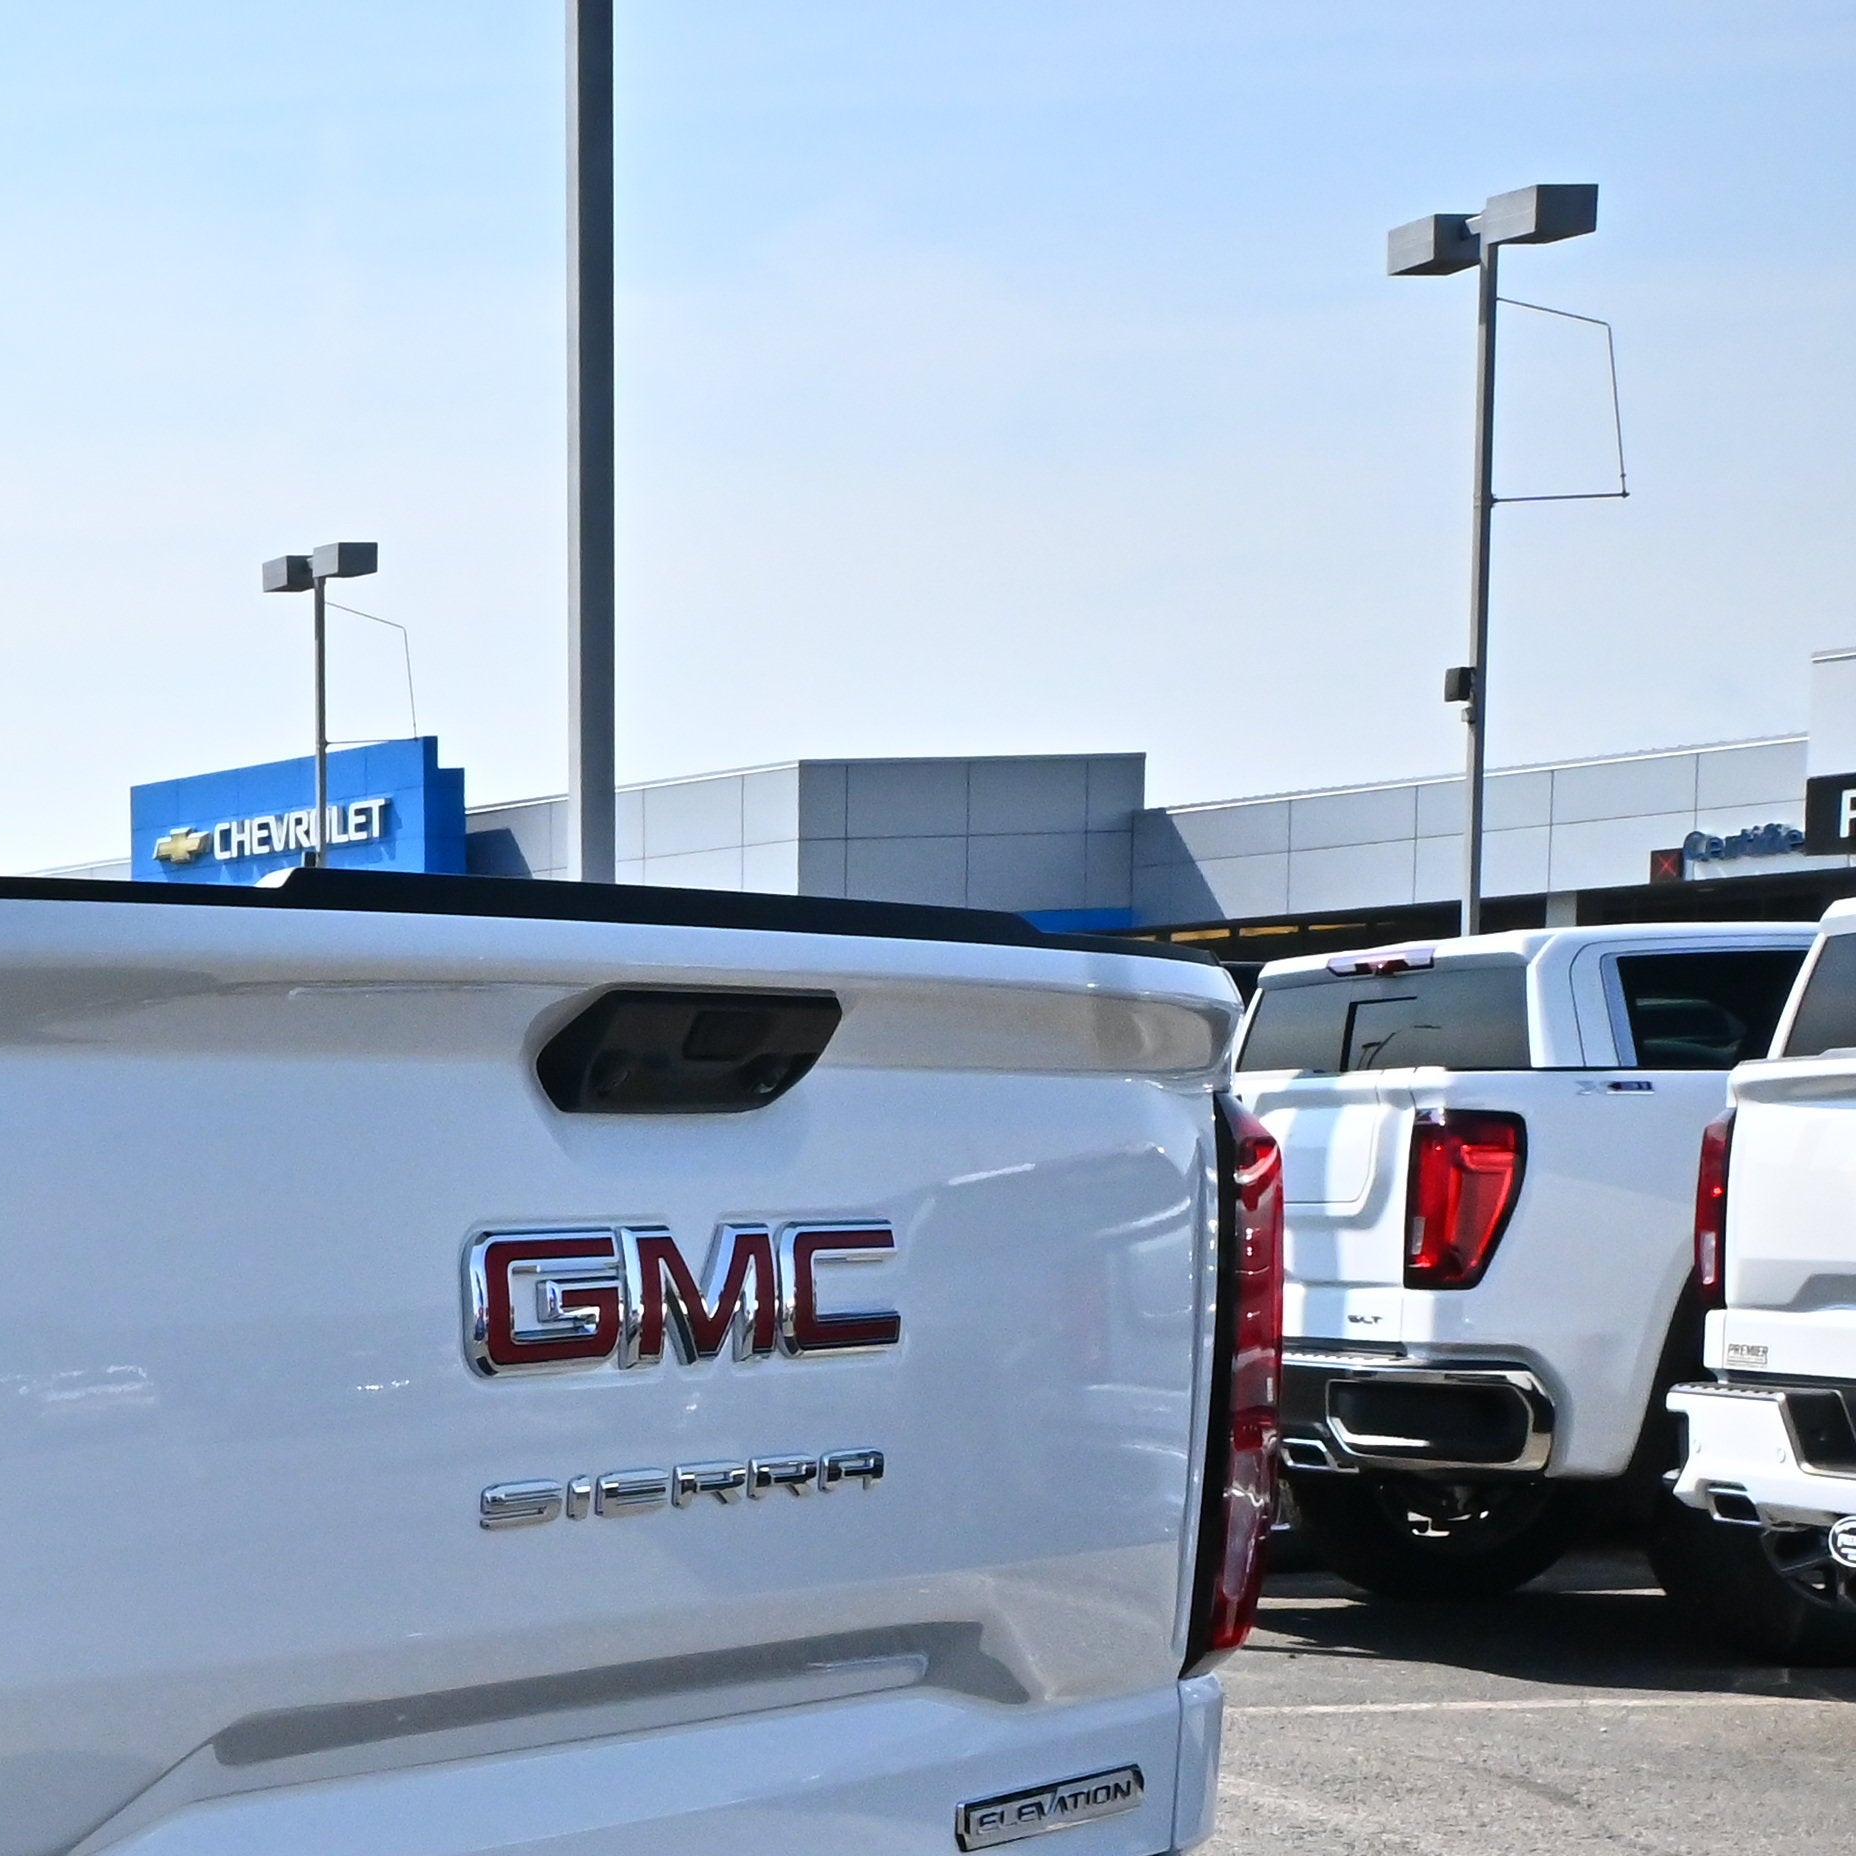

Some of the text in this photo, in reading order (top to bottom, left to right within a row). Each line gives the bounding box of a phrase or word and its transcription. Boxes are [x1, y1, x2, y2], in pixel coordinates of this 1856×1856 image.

[213, 798, 387, 861] CHEVROLET
[461, 1219, 902, 1378] GMC
[478, 1446, 886, 1530] SIERRA
[975, 1779, 1134, 1837] ELEVATION
